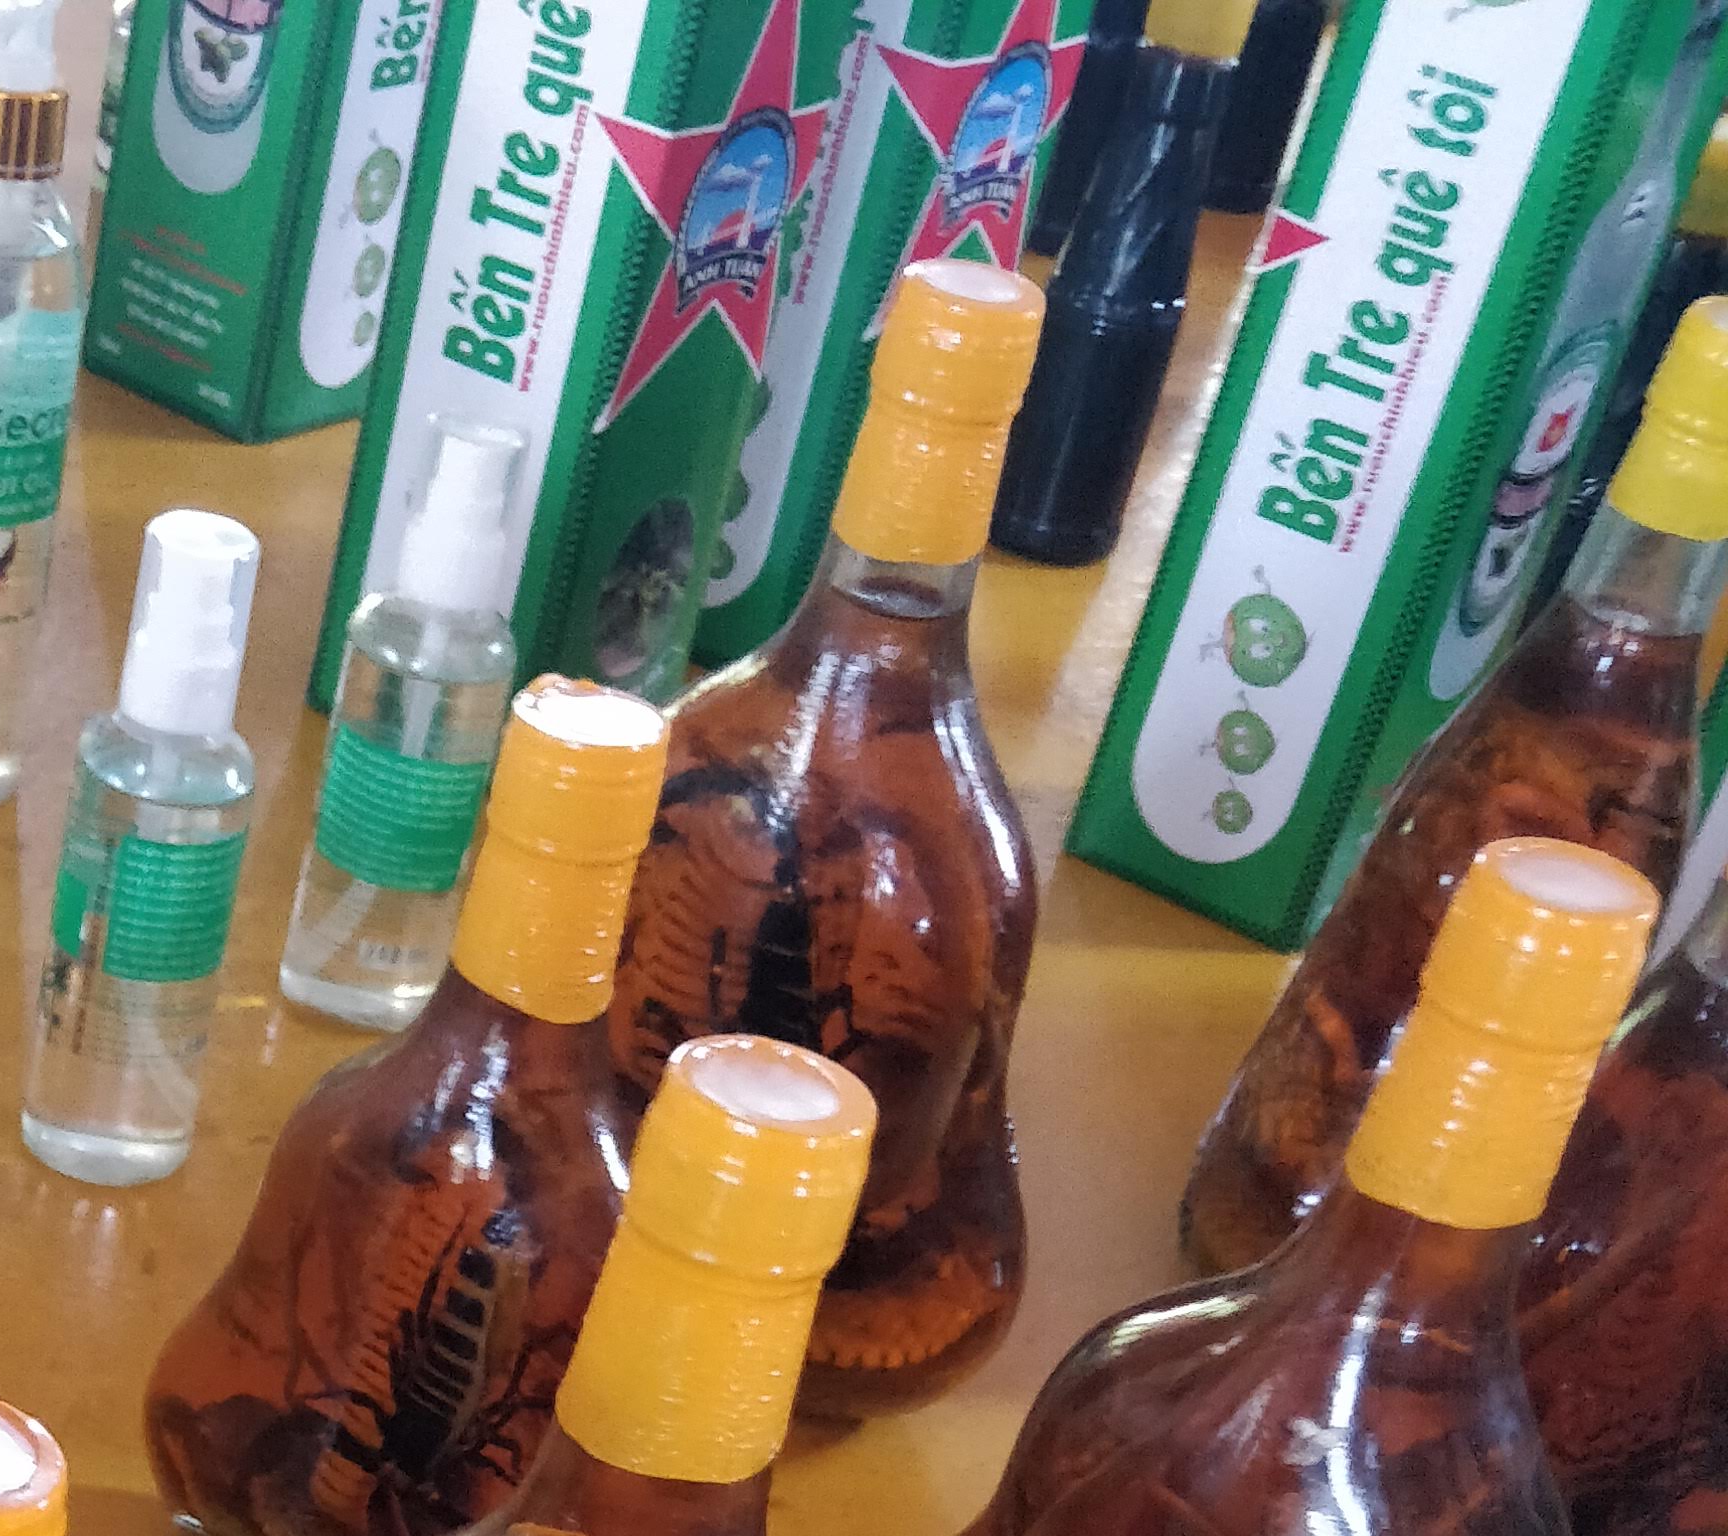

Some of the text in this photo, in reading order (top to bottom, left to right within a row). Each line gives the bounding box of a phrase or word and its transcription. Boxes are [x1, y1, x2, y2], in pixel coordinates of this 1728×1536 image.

[470, 131, 561, 238] Tre
[442, 254, 536, 385] Bến
[1256, 63, 1499, 545] Bến Tre quê tôi
